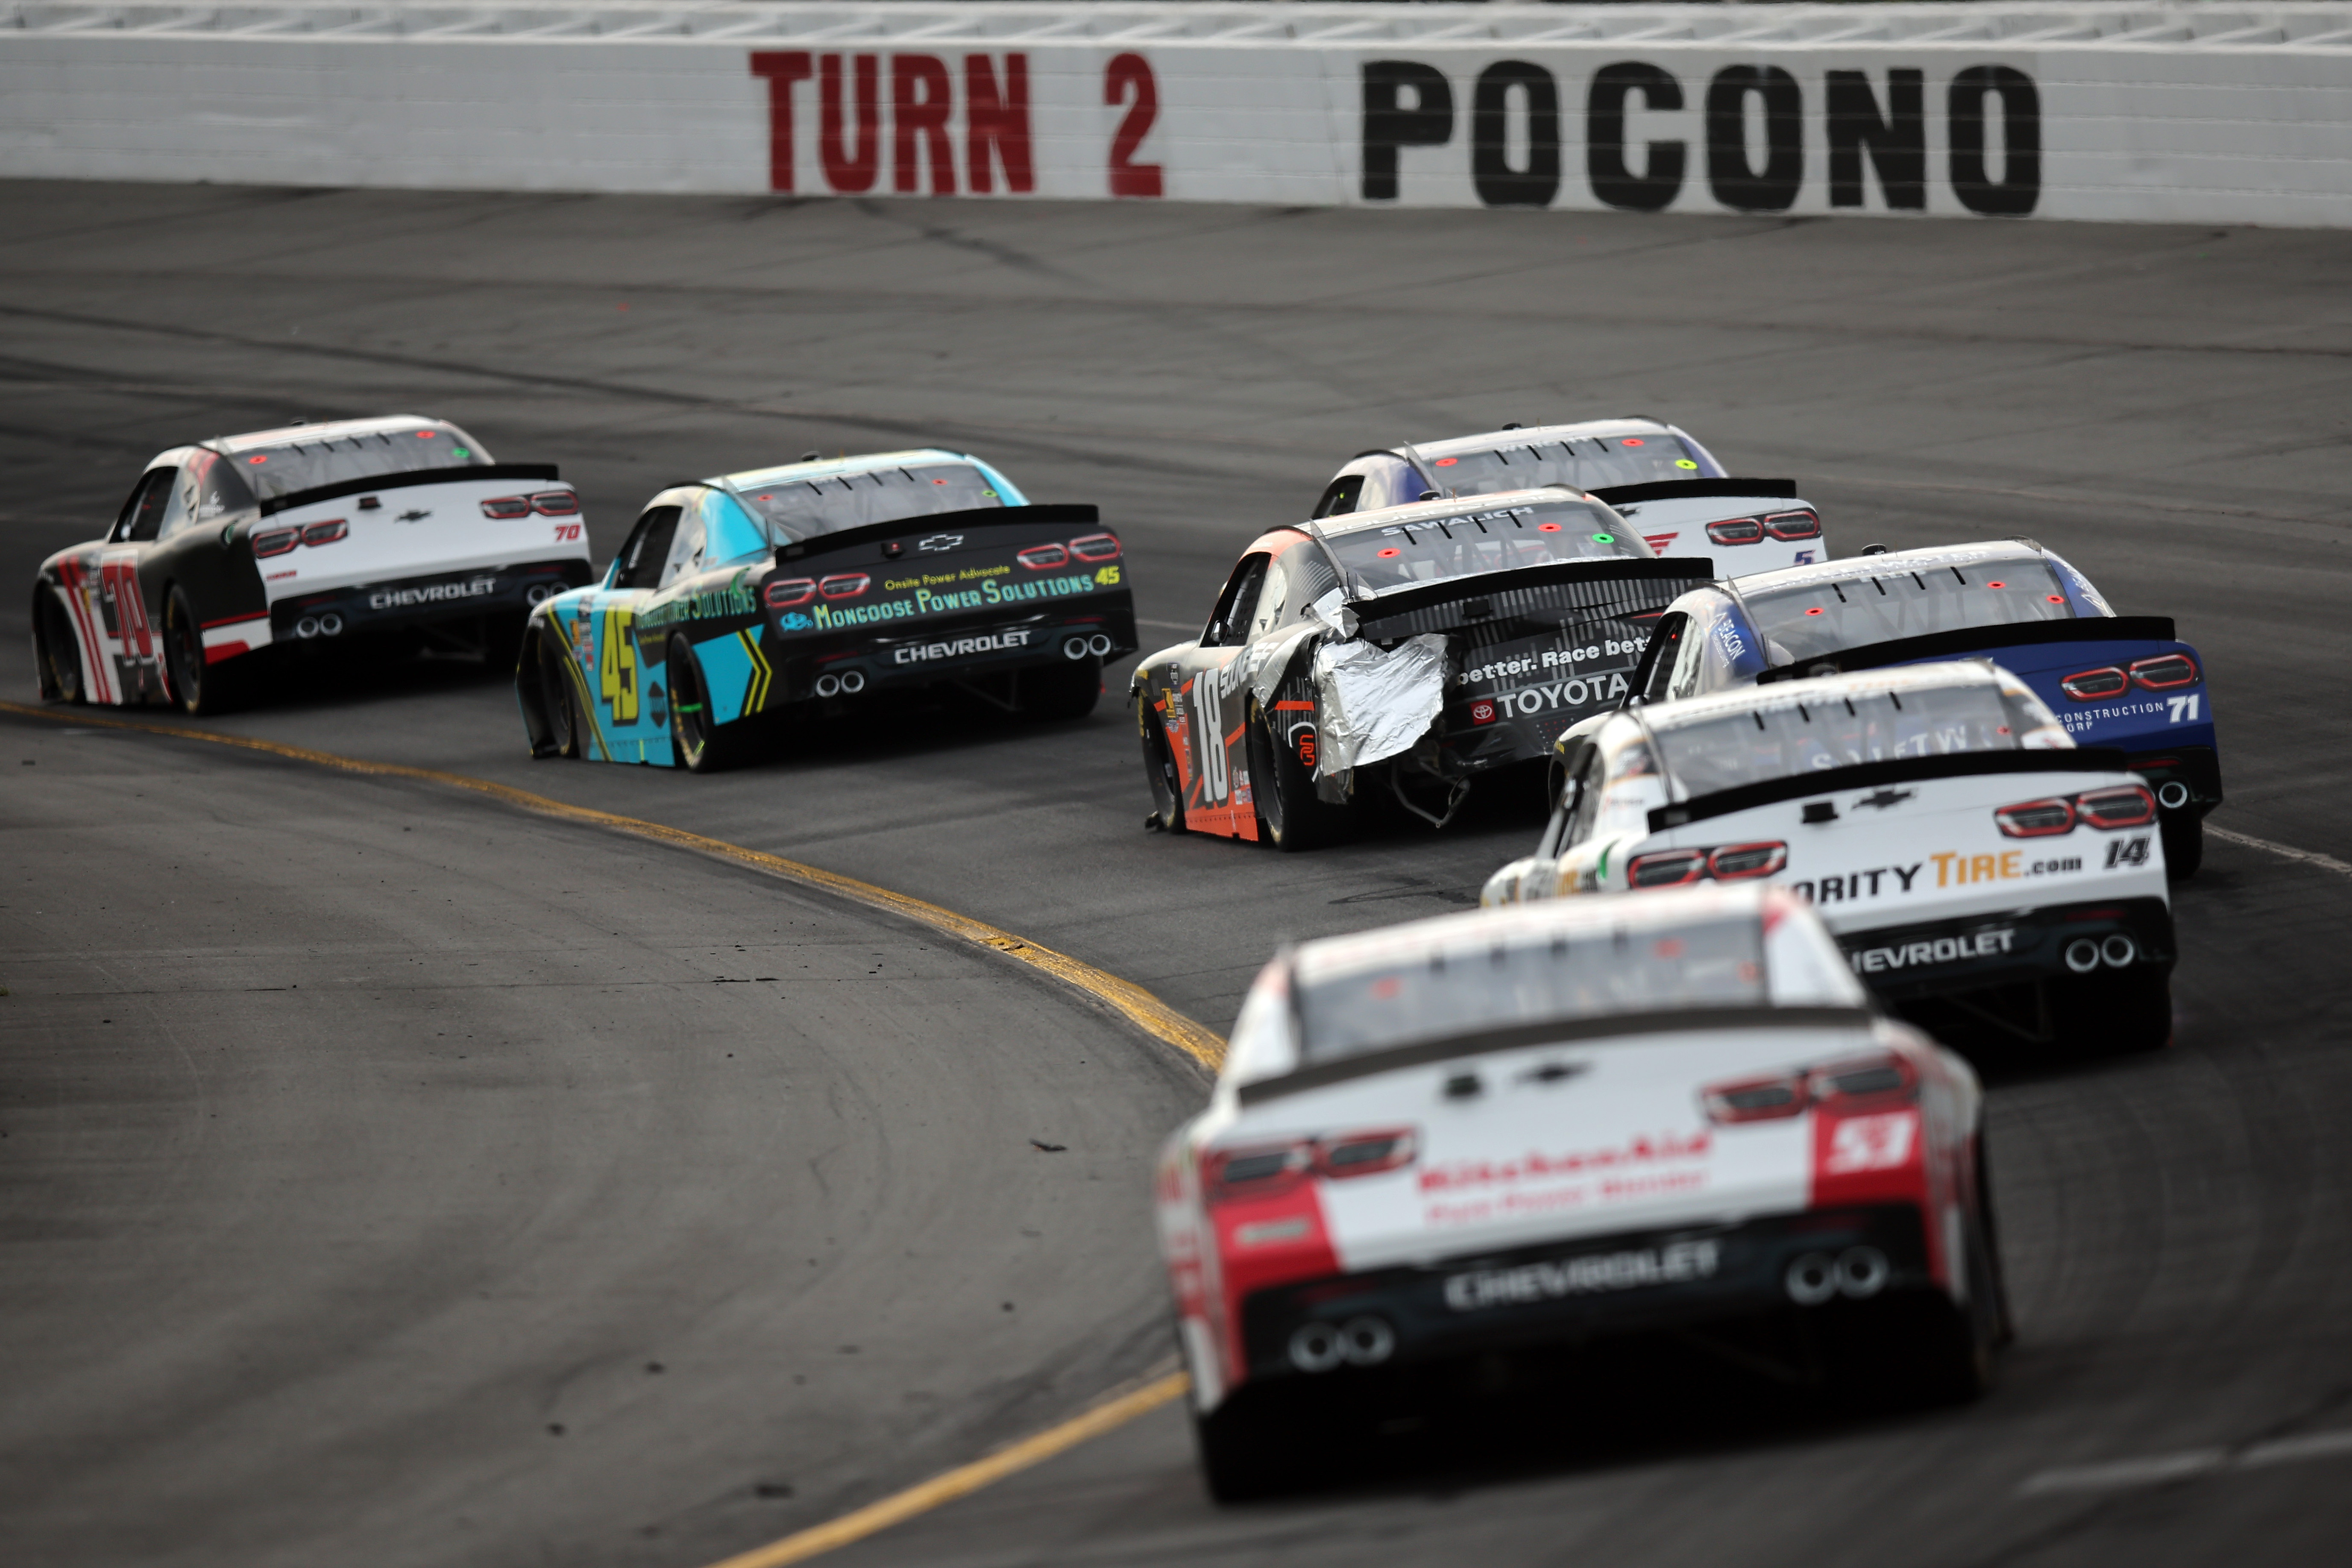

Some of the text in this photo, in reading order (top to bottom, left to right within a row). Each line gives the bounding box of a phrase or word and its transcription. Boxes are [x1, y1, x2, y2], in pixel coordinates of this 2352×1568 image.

[751, 51, 1163, 196] TURN 2
[1360, 60, 2041, 216] POCONO
[555, 525, 581, 541] 70
[1381, 506, 1534, 536] SAWALICH
[885, 565, 1011, 591] Onsite Power Advocate
[1095, 565, 1120, 585] 45
[101, 556, 154, 666] 70
[370, 578, 495, 610] CHEVROLET
[812, 574, 1094, 630] MONGOOSE POWER SOLUTIONS
[895, 630, 1030, 664] CHEVROLET
[1541, 645, 1600, 668] Race
[601, 604, 639, 725] 45
[1497, 673, 1628, 718] TOYOTA
[2056, 702, 2164, 723] CONSTRUCTION
[2167, 694, 2200, 723] 71
[1193, 667, 1229, 803] 18
[2067, 721, 2092, 732] ORP
[2103, 835, 2151, 870] 14
[1442, 1239, 1722, 1313] CHEVROLET
